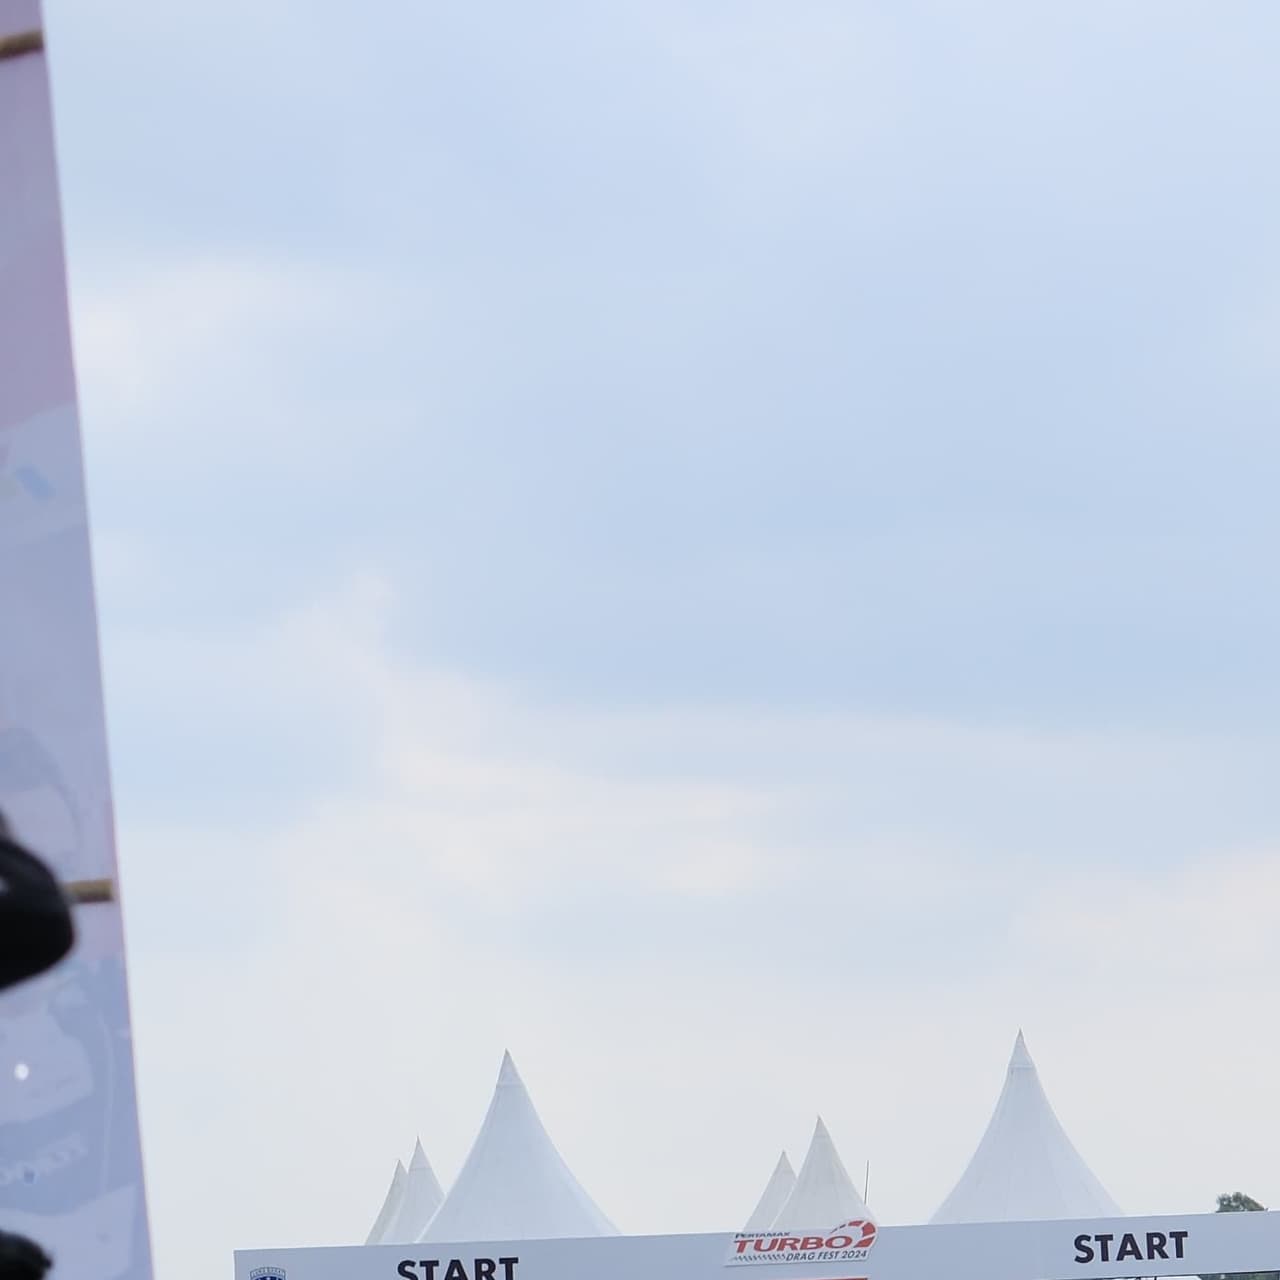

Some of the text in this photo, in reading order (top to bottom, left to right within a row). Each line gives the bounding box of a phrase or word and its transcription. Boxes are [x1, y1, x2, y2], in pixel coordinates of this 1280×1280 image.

[734, 1235, 853, 1254] TURBO
[1073, 1231, 1188, 1264] START
[786, 1250, 867, 1262] DRAG FEST 2024
